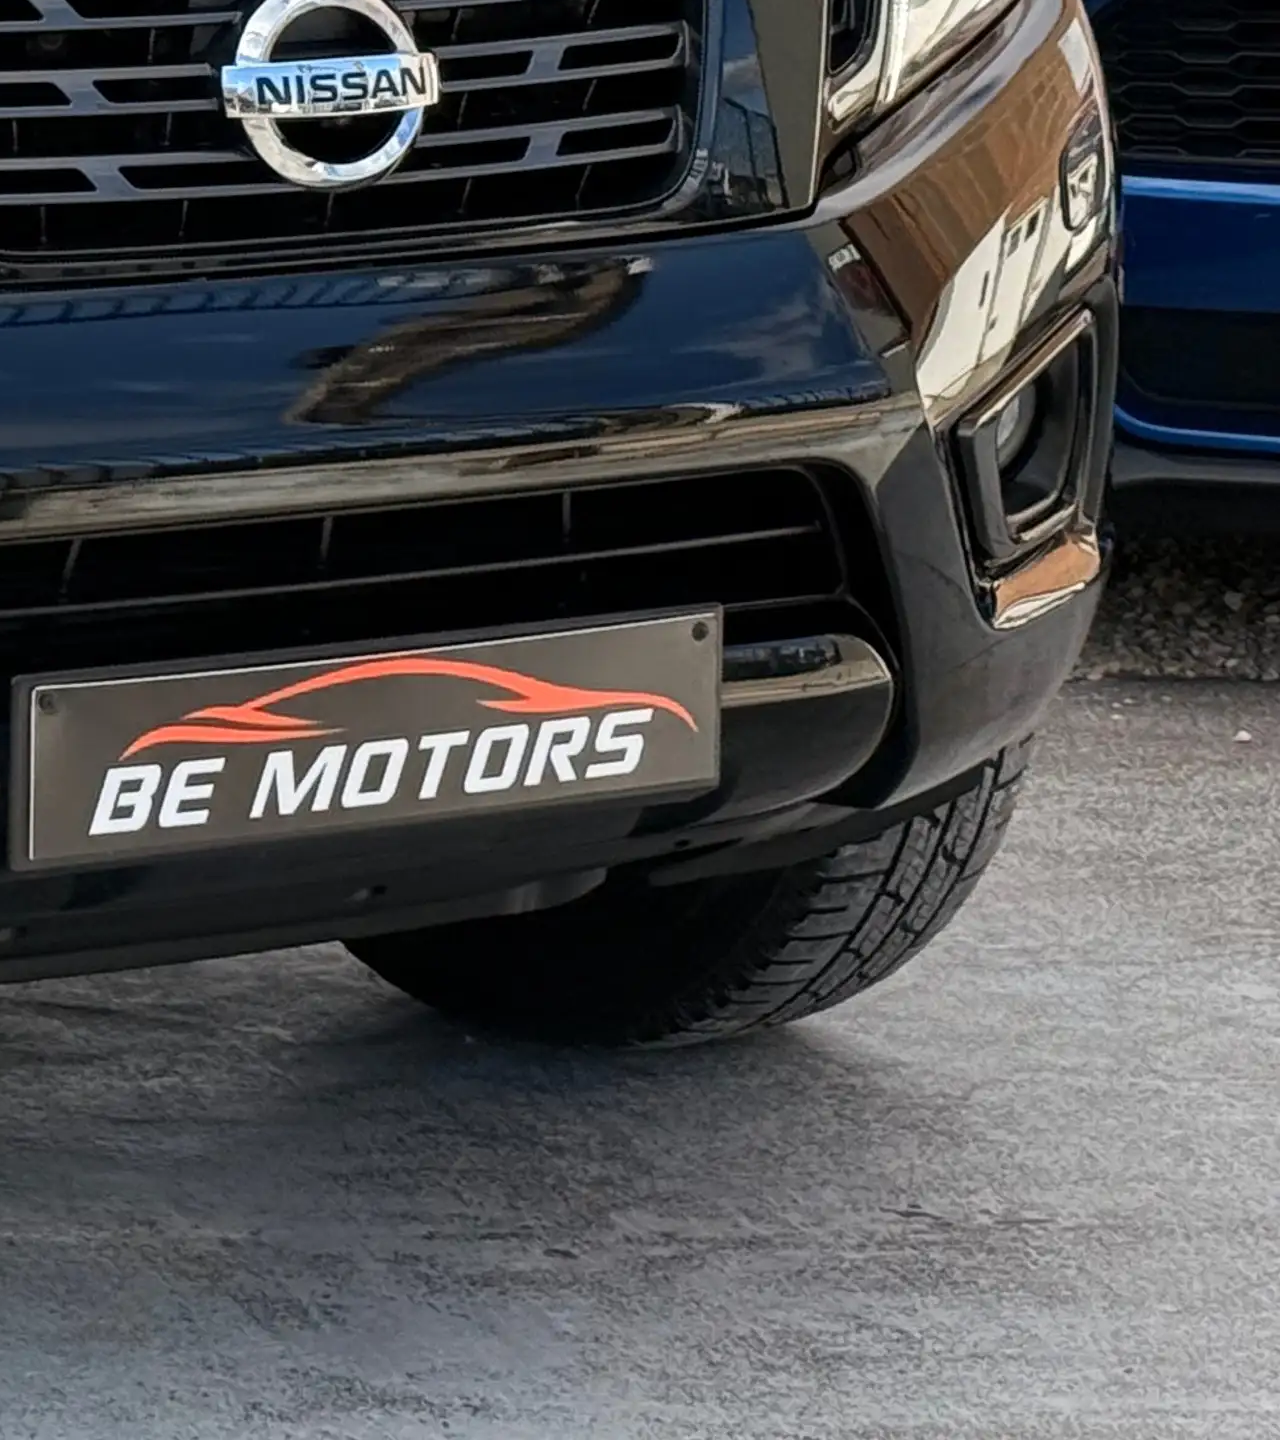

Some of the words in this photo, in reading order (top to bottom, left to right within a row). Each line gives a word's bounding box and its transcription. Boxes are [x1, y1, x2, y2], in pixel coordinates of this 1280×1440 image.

[256, 66, 427, 105] NISSAN
[88, 756, 226, 836] BE
[248, 707, 655, 819] MOTORS
